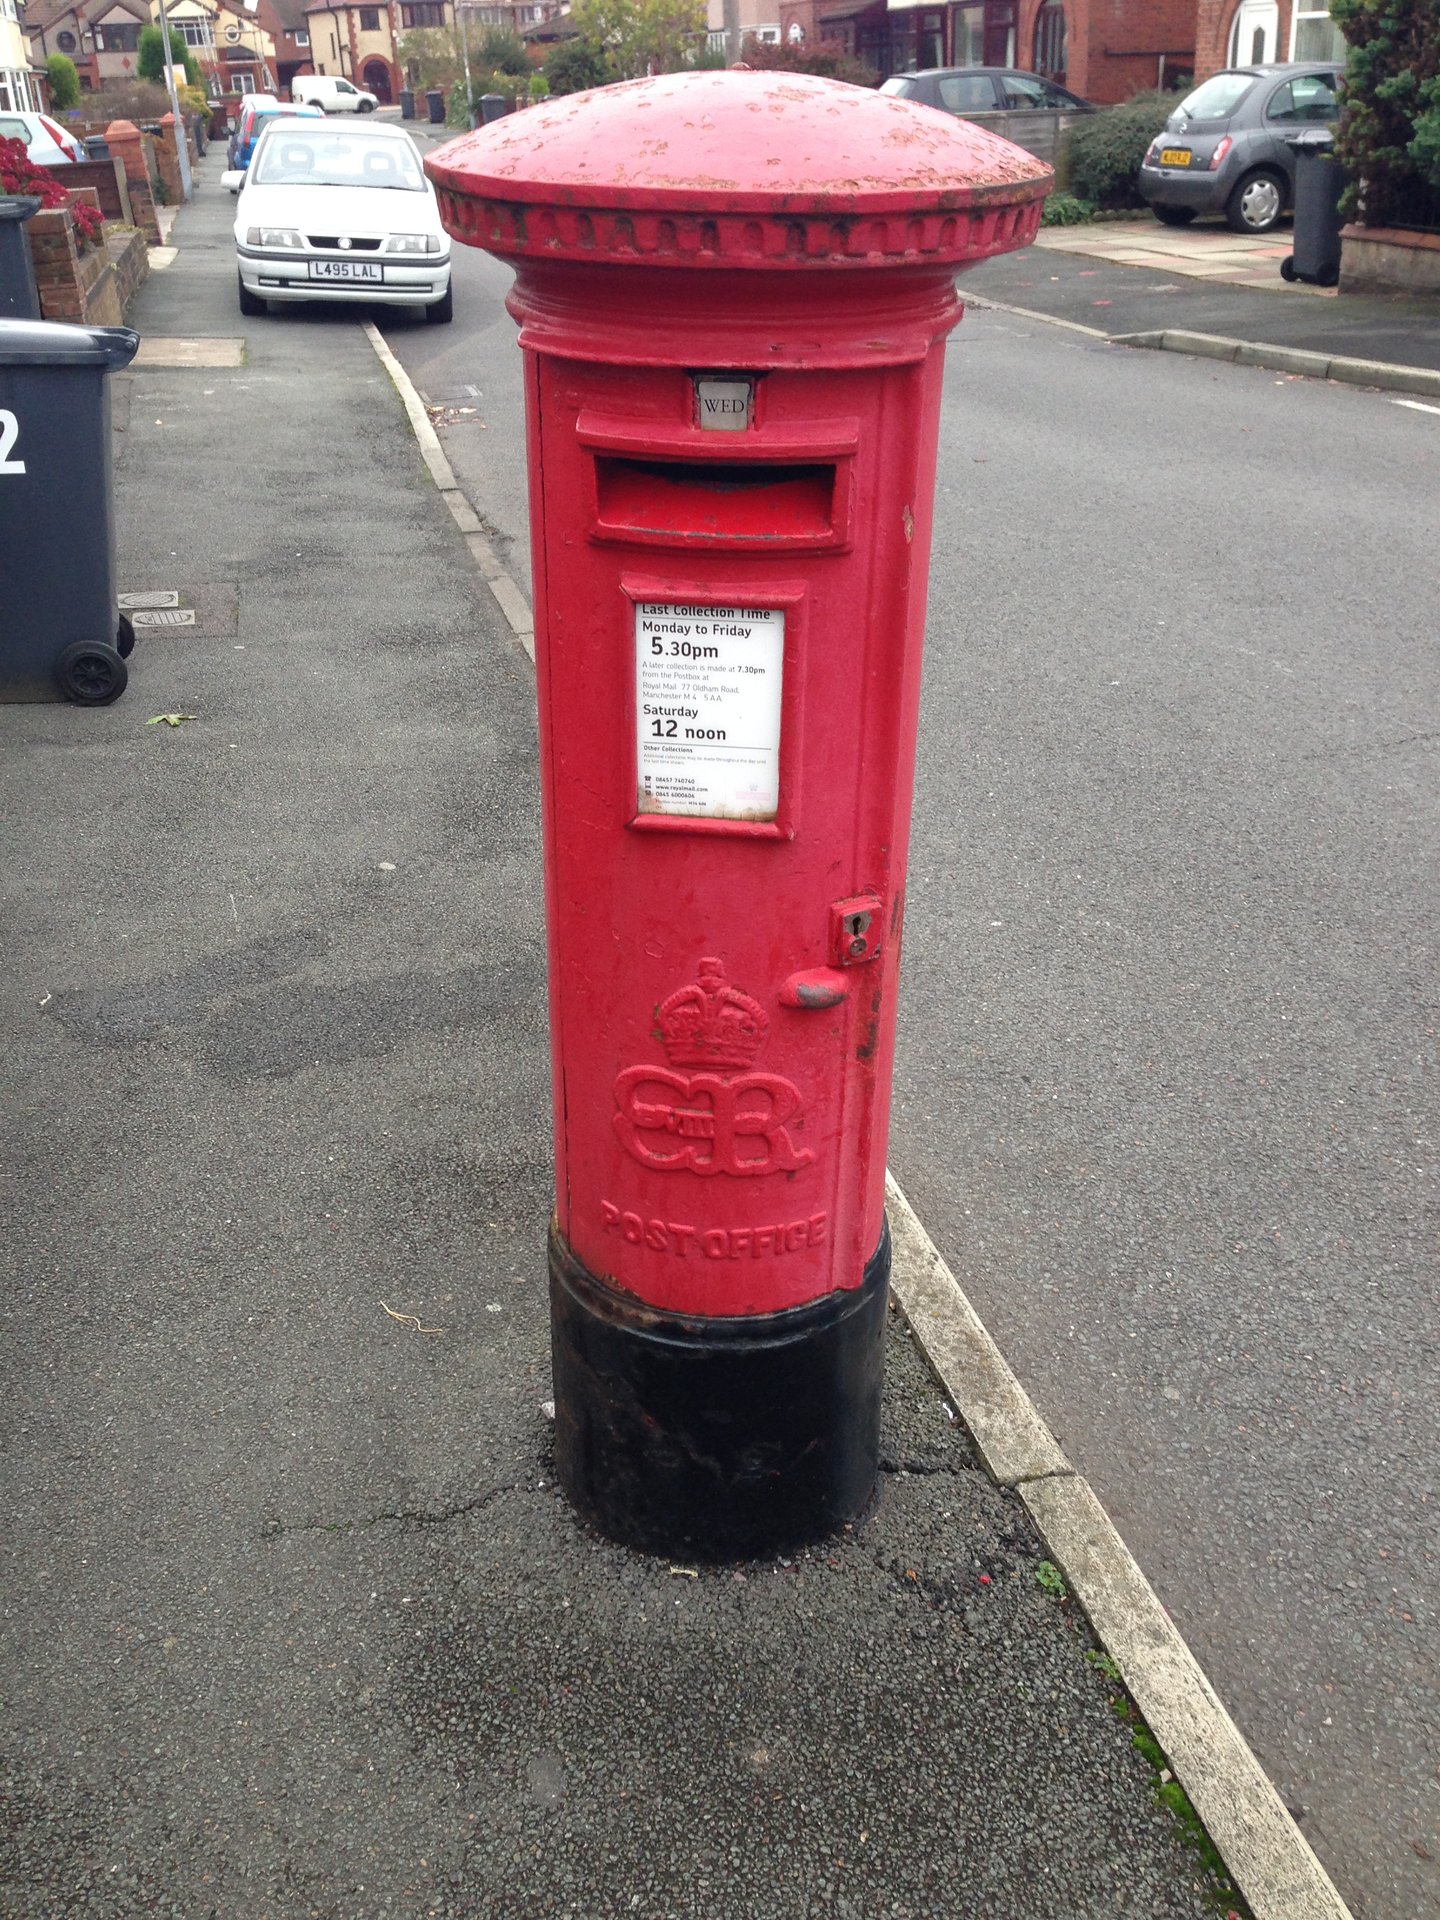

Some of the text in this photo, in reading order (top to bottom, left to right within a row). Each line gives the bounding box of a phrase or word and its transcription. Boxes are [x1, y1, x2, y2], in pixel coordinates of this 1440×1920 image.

[315, 262, 377, 278] L495 LAL
[704, 399, 745, 413] WED
[642, 604, 771, 619] Last Collection Time
[642, 621, 752, 638] Monday to Friday
[651, 636, 719, 660] 5.30pm
[642, 671, 659, 679] from
[660, 671, 672, 679] the
[674, 672, 701, 680] Postbox
[666, 663, 698, 671] collection
[738, 666, 766, 675] 7.30pm
[643, 682, 661, 690] Royal
[692, 684, 719, 693] Oldham
[643, 691, 682, 700] Manchester
[643, 704, 699, 719] Saturday
[651, 719, 726, 740] 12 noon
[655, 784, 708, 792] www.royalmail.com
[601, 1199, 828, 1260] POST OFFICE
